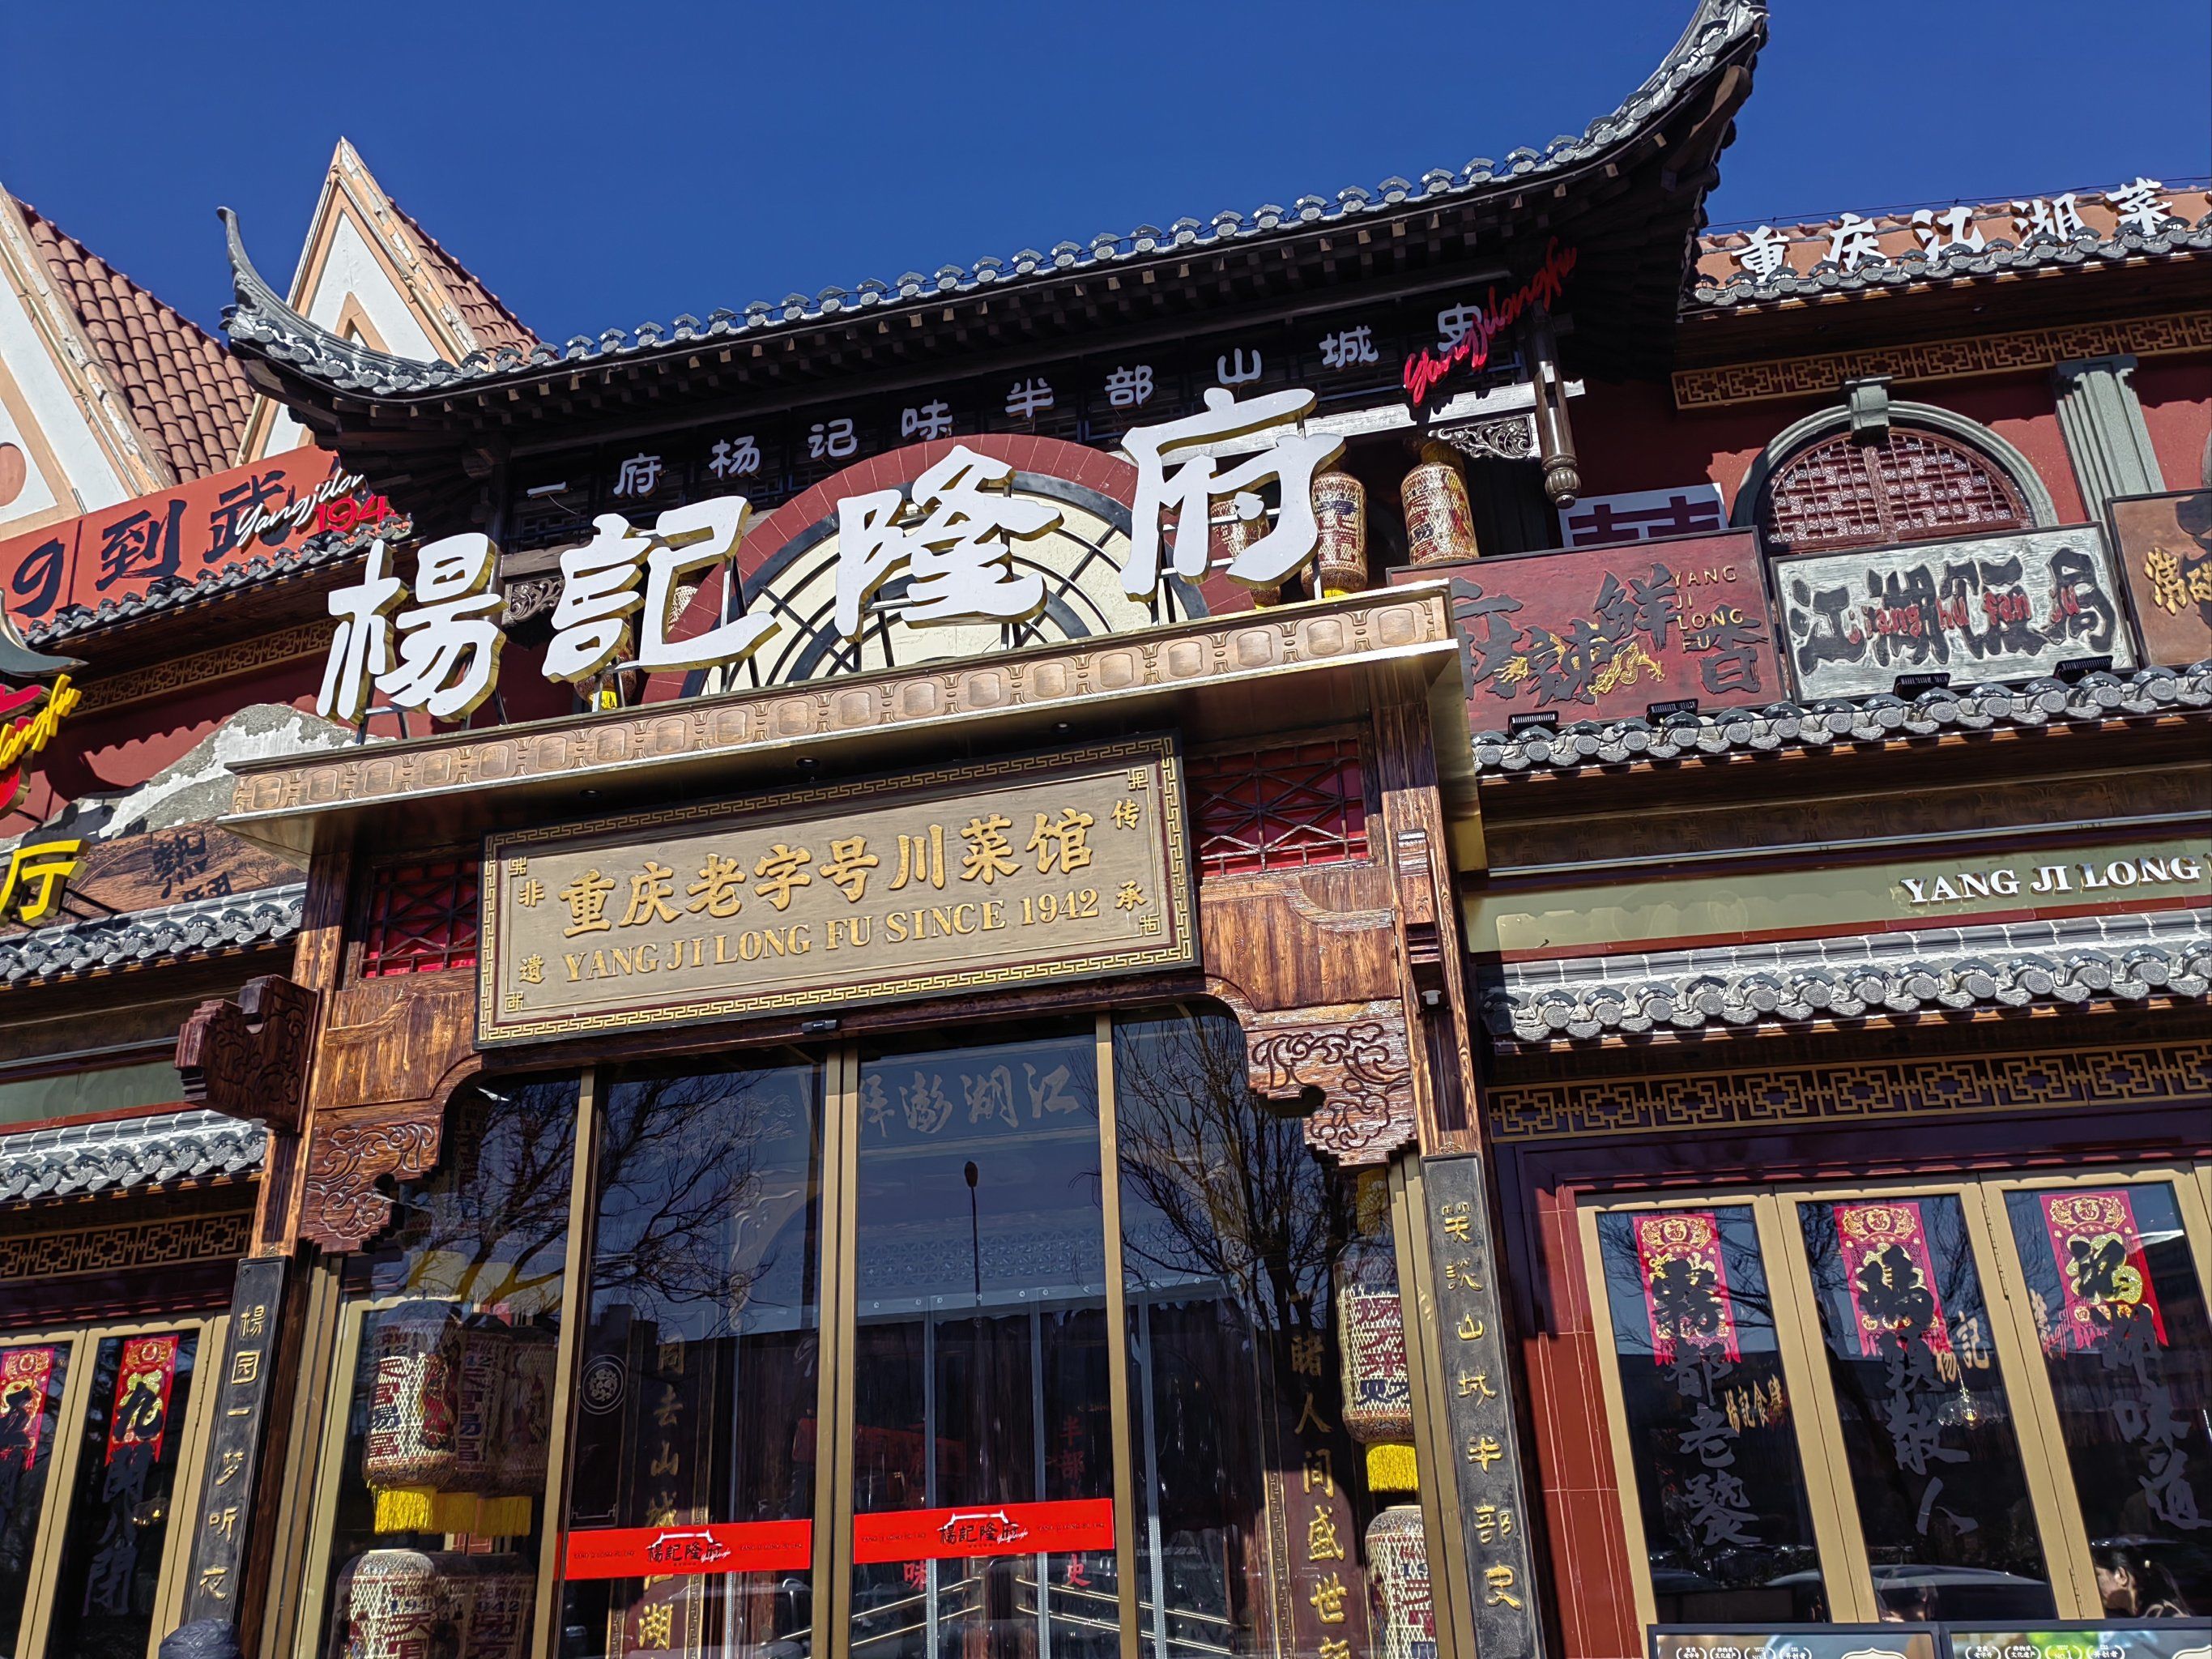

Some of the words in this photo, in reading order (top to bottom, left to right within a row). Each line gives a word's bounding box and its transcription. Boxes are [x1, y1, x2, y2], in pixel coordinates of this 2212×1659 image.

[1732, 177, 2172, 283] 重庆江湖菜
[315, 495, 395, 534] 194
[317, 387, 1345, 723] 楊記隆府
[1673, 565, 1737, 590] YANG
[1676, 592, 1693, 610] JI
[1677, 608, 1745, 632] LONG
[1682, 633, 1711, 653] FU
[558, 807, 1096, 939] 重庆老字号川菜馆
[1899, 868, 2020, 906] YANG
[2075, 856, 2202, 888] LONG
[562, 943, 658, 983] YANG
[714, 923, 812, 964] LONG
[825, 915, 873, 951] FU
[885, 899, 1007, 944] SINCE
[1021, 888, 1099, 927] 1942
[940, 1520, 1020, 1545] 楊記隆府
[648, 1540, 724, 1564] 楊記隆府
